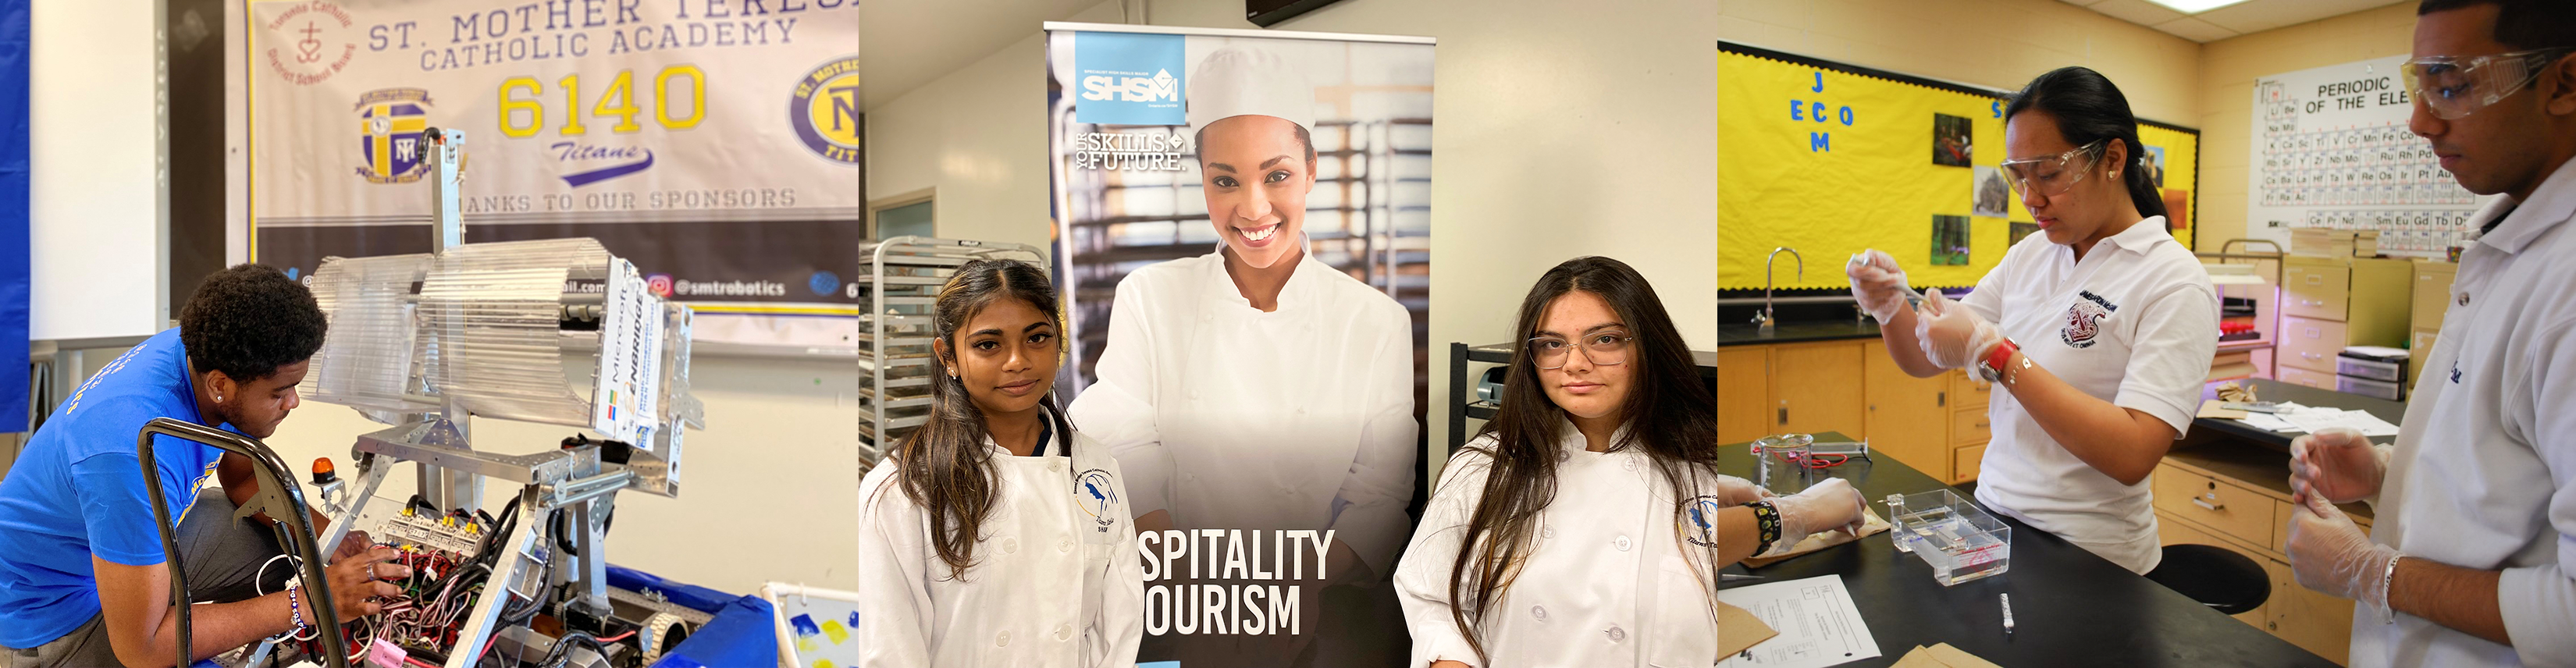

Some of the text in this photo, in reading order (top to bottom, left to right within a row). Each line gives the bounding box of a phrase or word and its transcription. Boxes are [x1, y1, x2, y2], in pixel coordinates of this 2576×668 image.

[368, 21, 426, 52] ST.
[450, 0, 640, 44] MOTHER
[420, 18, 797, 72] CATHOLIC ACADEMY
[1081, 75, 1178, 103] SHSM
[2318, 76, 2390, 98] PERIODIC
[498, 63, 708, 139] 6140
[2306, 100, 2325, 114] OF
[2336, 95, 2366, 111] THE
[1087, 132, 1170, 153] SKILLS,
[2382, 132, 2394, 141] Fe
[2400, 130, 2414, 140] Co
[550, 141, 639, 161] Titans
[1076, 133, 1088, 170] YOUR
[1087, 152, 1187, 171] FUTURE.
[2380, 152, 2394, 161] Ru
[2399, 151, 2413, 159] Rh
[2418, 149, 2432, 159] Pd
[2361, 172, 2374, 180] Re
[2379, 171, 2393, 180] Os
[2418, 169, 2429, 179] Pt
[2436, 169, 2452, 178] Au
[467, 187, 797, 213] ANKS TO OUR SPONSORS
[2375, 215, 2391, 226] Sm
[2396, 216, 2409, 226] Eu
[2414, 215, 2428, 226] Gd
[2435, 216, 2449, 226] Tb
[674, 278, 786, 297] @smtrobotics
[612, 286, 628, 383] Microsoft
[629, 292, 644, 396] ENBRIDGE
[388, 524, 407, 533] SPARK
[429, 535, 451, 545] SPARK
[453, 542, 474, 553] SPARK
[1137, 528, 1336, 582] SPITALITY
[1145, 584, 1300, 636] OURISM
